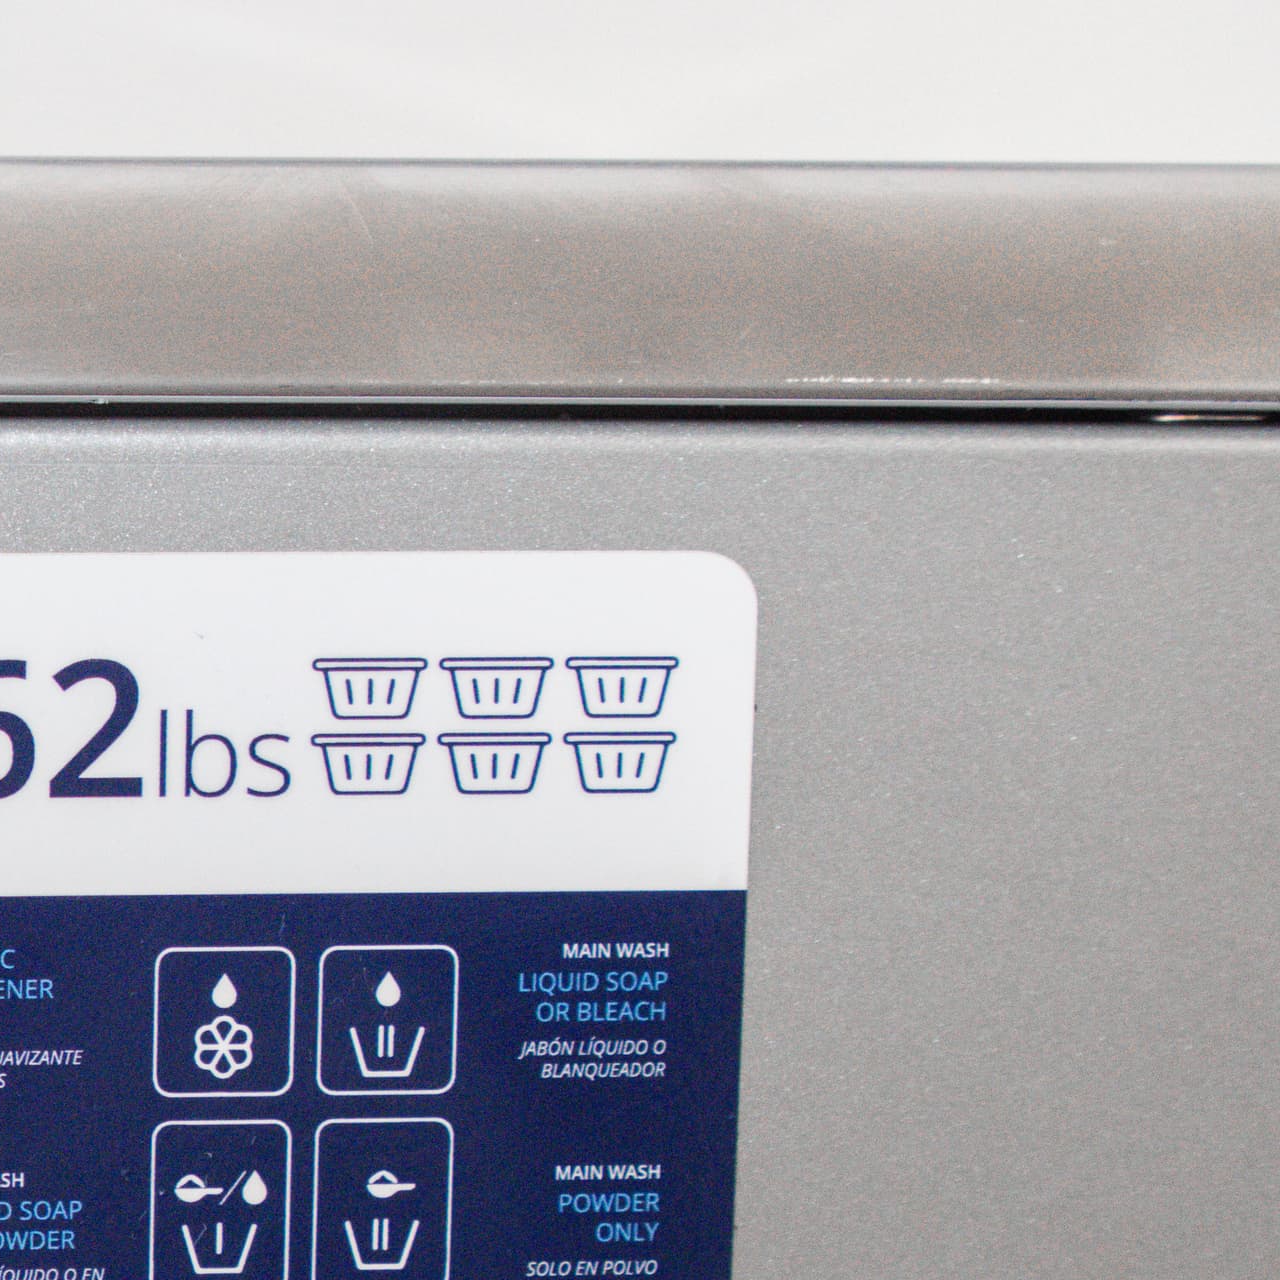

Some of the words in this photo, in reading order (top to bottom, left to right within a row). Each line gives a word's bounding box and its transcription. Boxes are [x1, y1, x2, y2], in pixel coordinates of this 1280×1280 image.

[563, 943, 611, 958] MAIN
[616, 942, 669, 958] WASH
[519, 972, 599, 996] LIQUID
[606, 971, 668, 992] SOAP
[536, 1002, 569, 1022] OR
[577, 1001, 666, 1022] BLEACH
[518, 1037, 575, 1060] JABÓN
[578, 1036, 648, 1058] LÍQUIDO
[652, 1039, 666, 1055] O
[541, 1062, 666, 1081] BLANQUEADOR
[555, 1165, 603, 1180] MAIN
[608, 1164, 661, 1180] WASH
[20, 1200, 82, 1221] SOAP
[559, 1192, 659, 1213] POWDER
[595, 1222, 659, 1242] ONLY
[526, 1261, 571, 1277] SOLO
[575, 1261, 599, 1276] EN
[602, 1259, 658, 1275] POLVO
